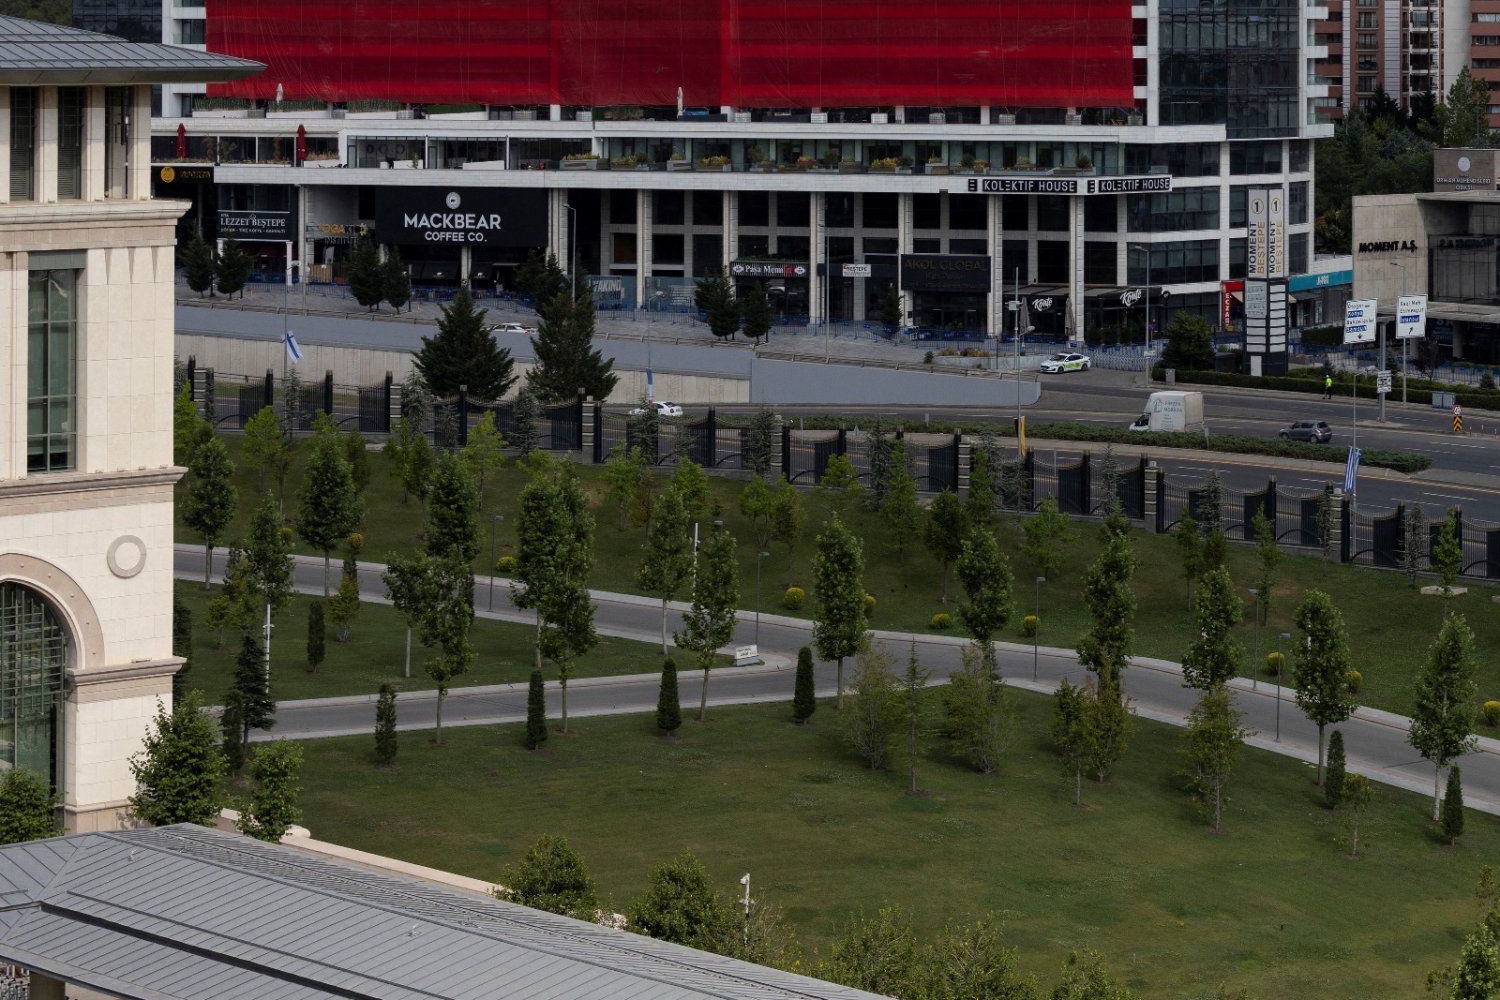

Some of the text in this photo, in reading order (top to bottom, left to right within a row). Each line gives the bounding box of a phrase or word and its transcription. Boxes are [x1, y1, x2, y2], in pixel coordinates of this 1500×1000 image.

[1038, 181, 1076, 192] HOUSE
[1142, 178, 1170, 190] HOUSE
[221, 217, 286, 228] LEZZET BEŞTEPE
[404, 213, 501, 230] MACKBEAR
[424, 231, 488, 242] COFFEE CO.
[1249, 221, 1257, 273] MOMENT
[1359, 241, 1399, 254] MOMENT
